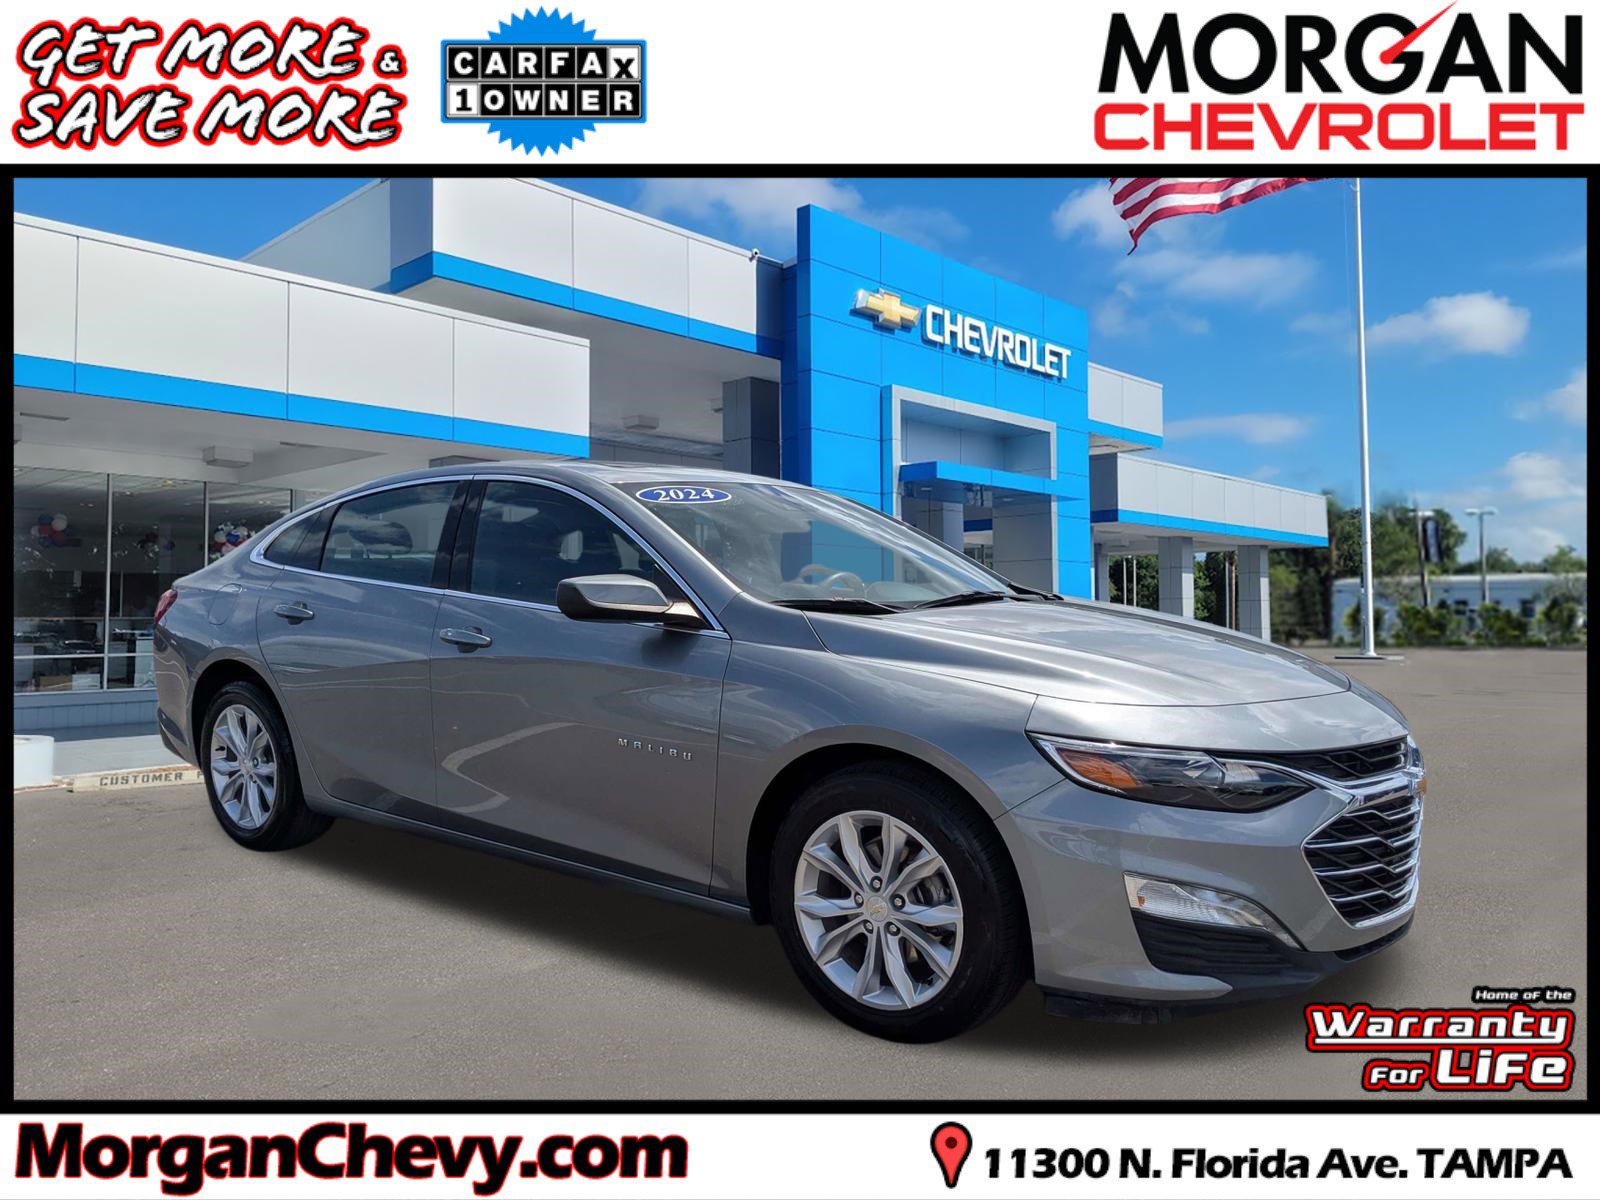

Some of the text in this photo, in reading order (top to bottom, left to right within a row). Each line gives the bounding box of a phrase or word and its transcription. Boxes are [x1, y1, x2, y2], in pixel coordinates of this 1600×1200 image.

[924, 304, 1072, 379] CHEVROLET
[653, 488, 715, 501] 2024
[618, 738, 692, 760] MALIBU
[100, 772, 183, 786] CUSTOMER
